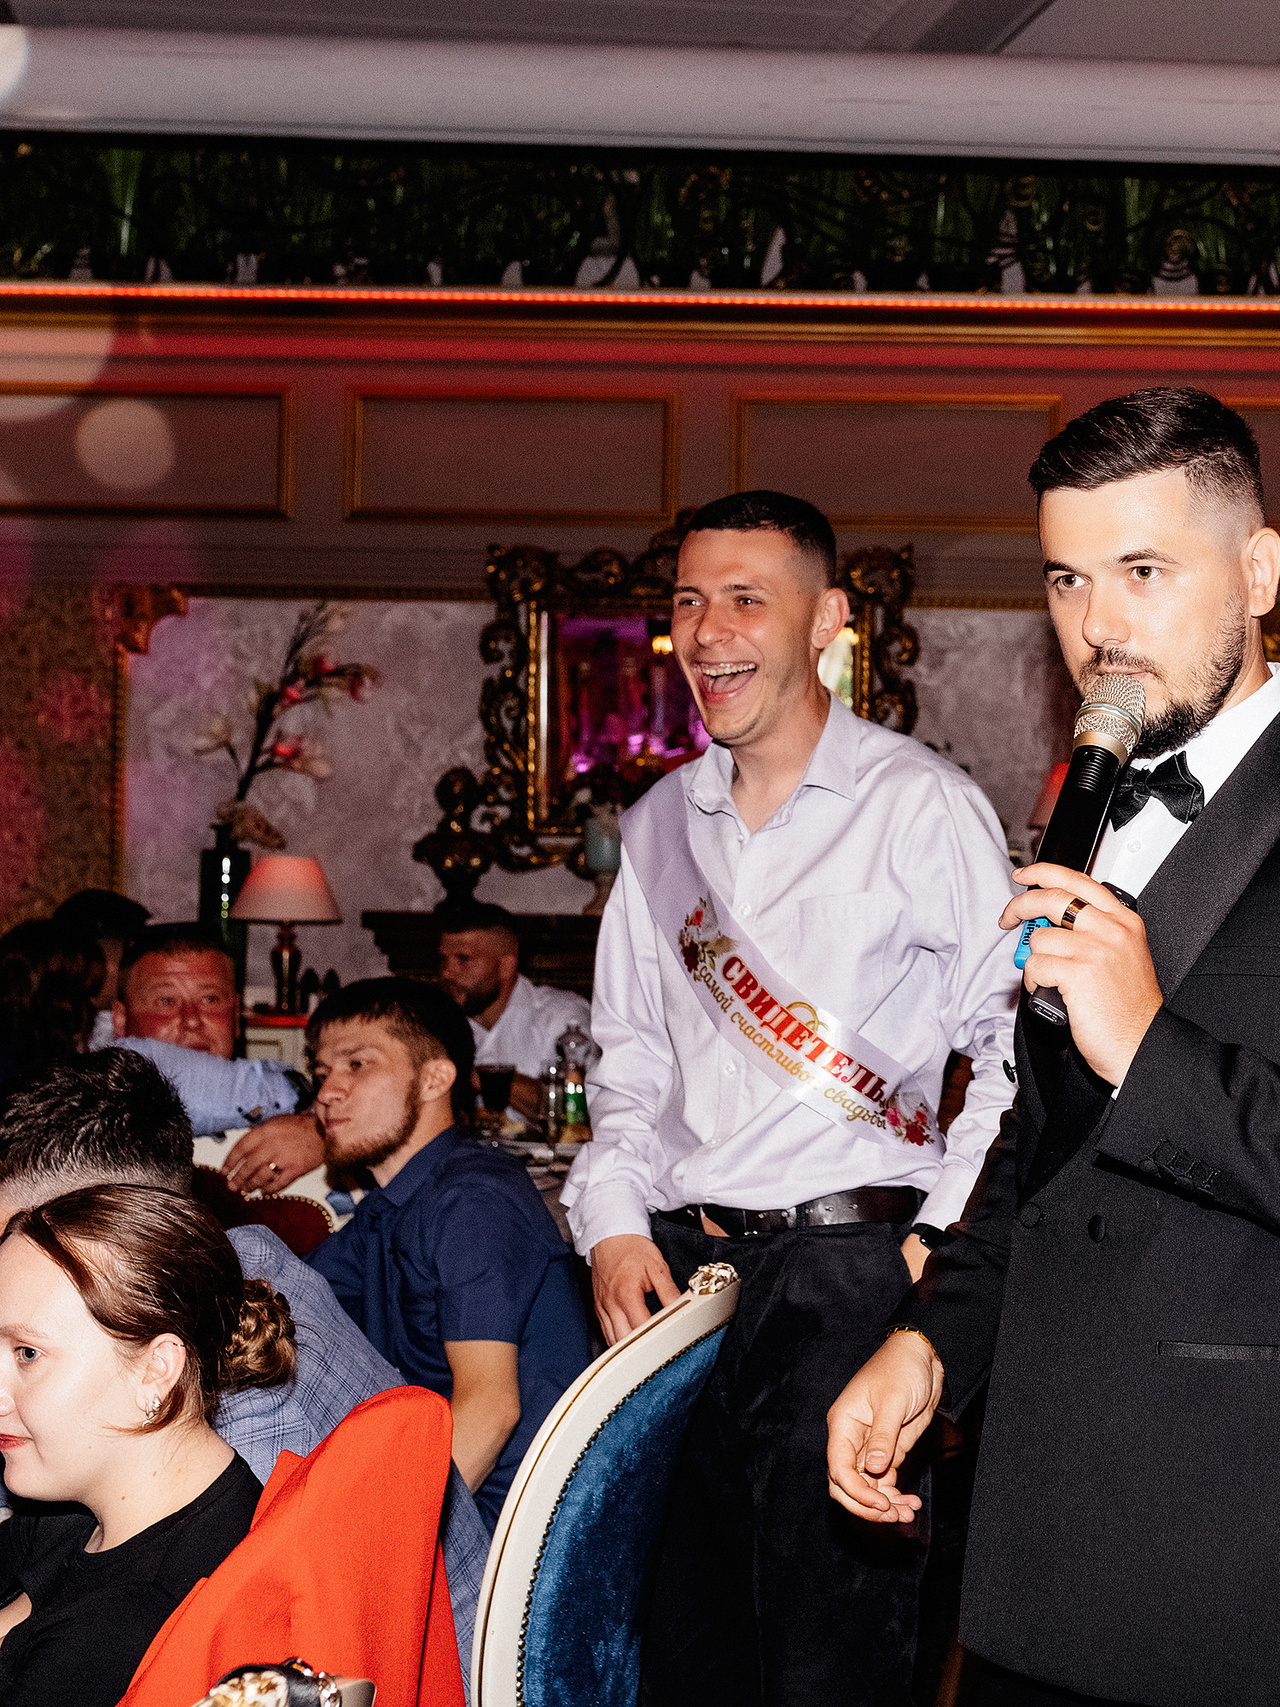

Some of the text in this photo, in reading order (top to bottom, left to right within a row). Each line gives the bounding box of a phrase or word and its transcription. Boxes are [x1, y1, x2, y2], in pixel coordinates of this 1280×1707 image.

[1022, 920, 1036, 945] IPRO
[699, 965, 734, 1012] самой
[824, 1088, 887, 1129] свадьбы
[721, 956, 888, 1103] СВИДЕТЕЛЬ
